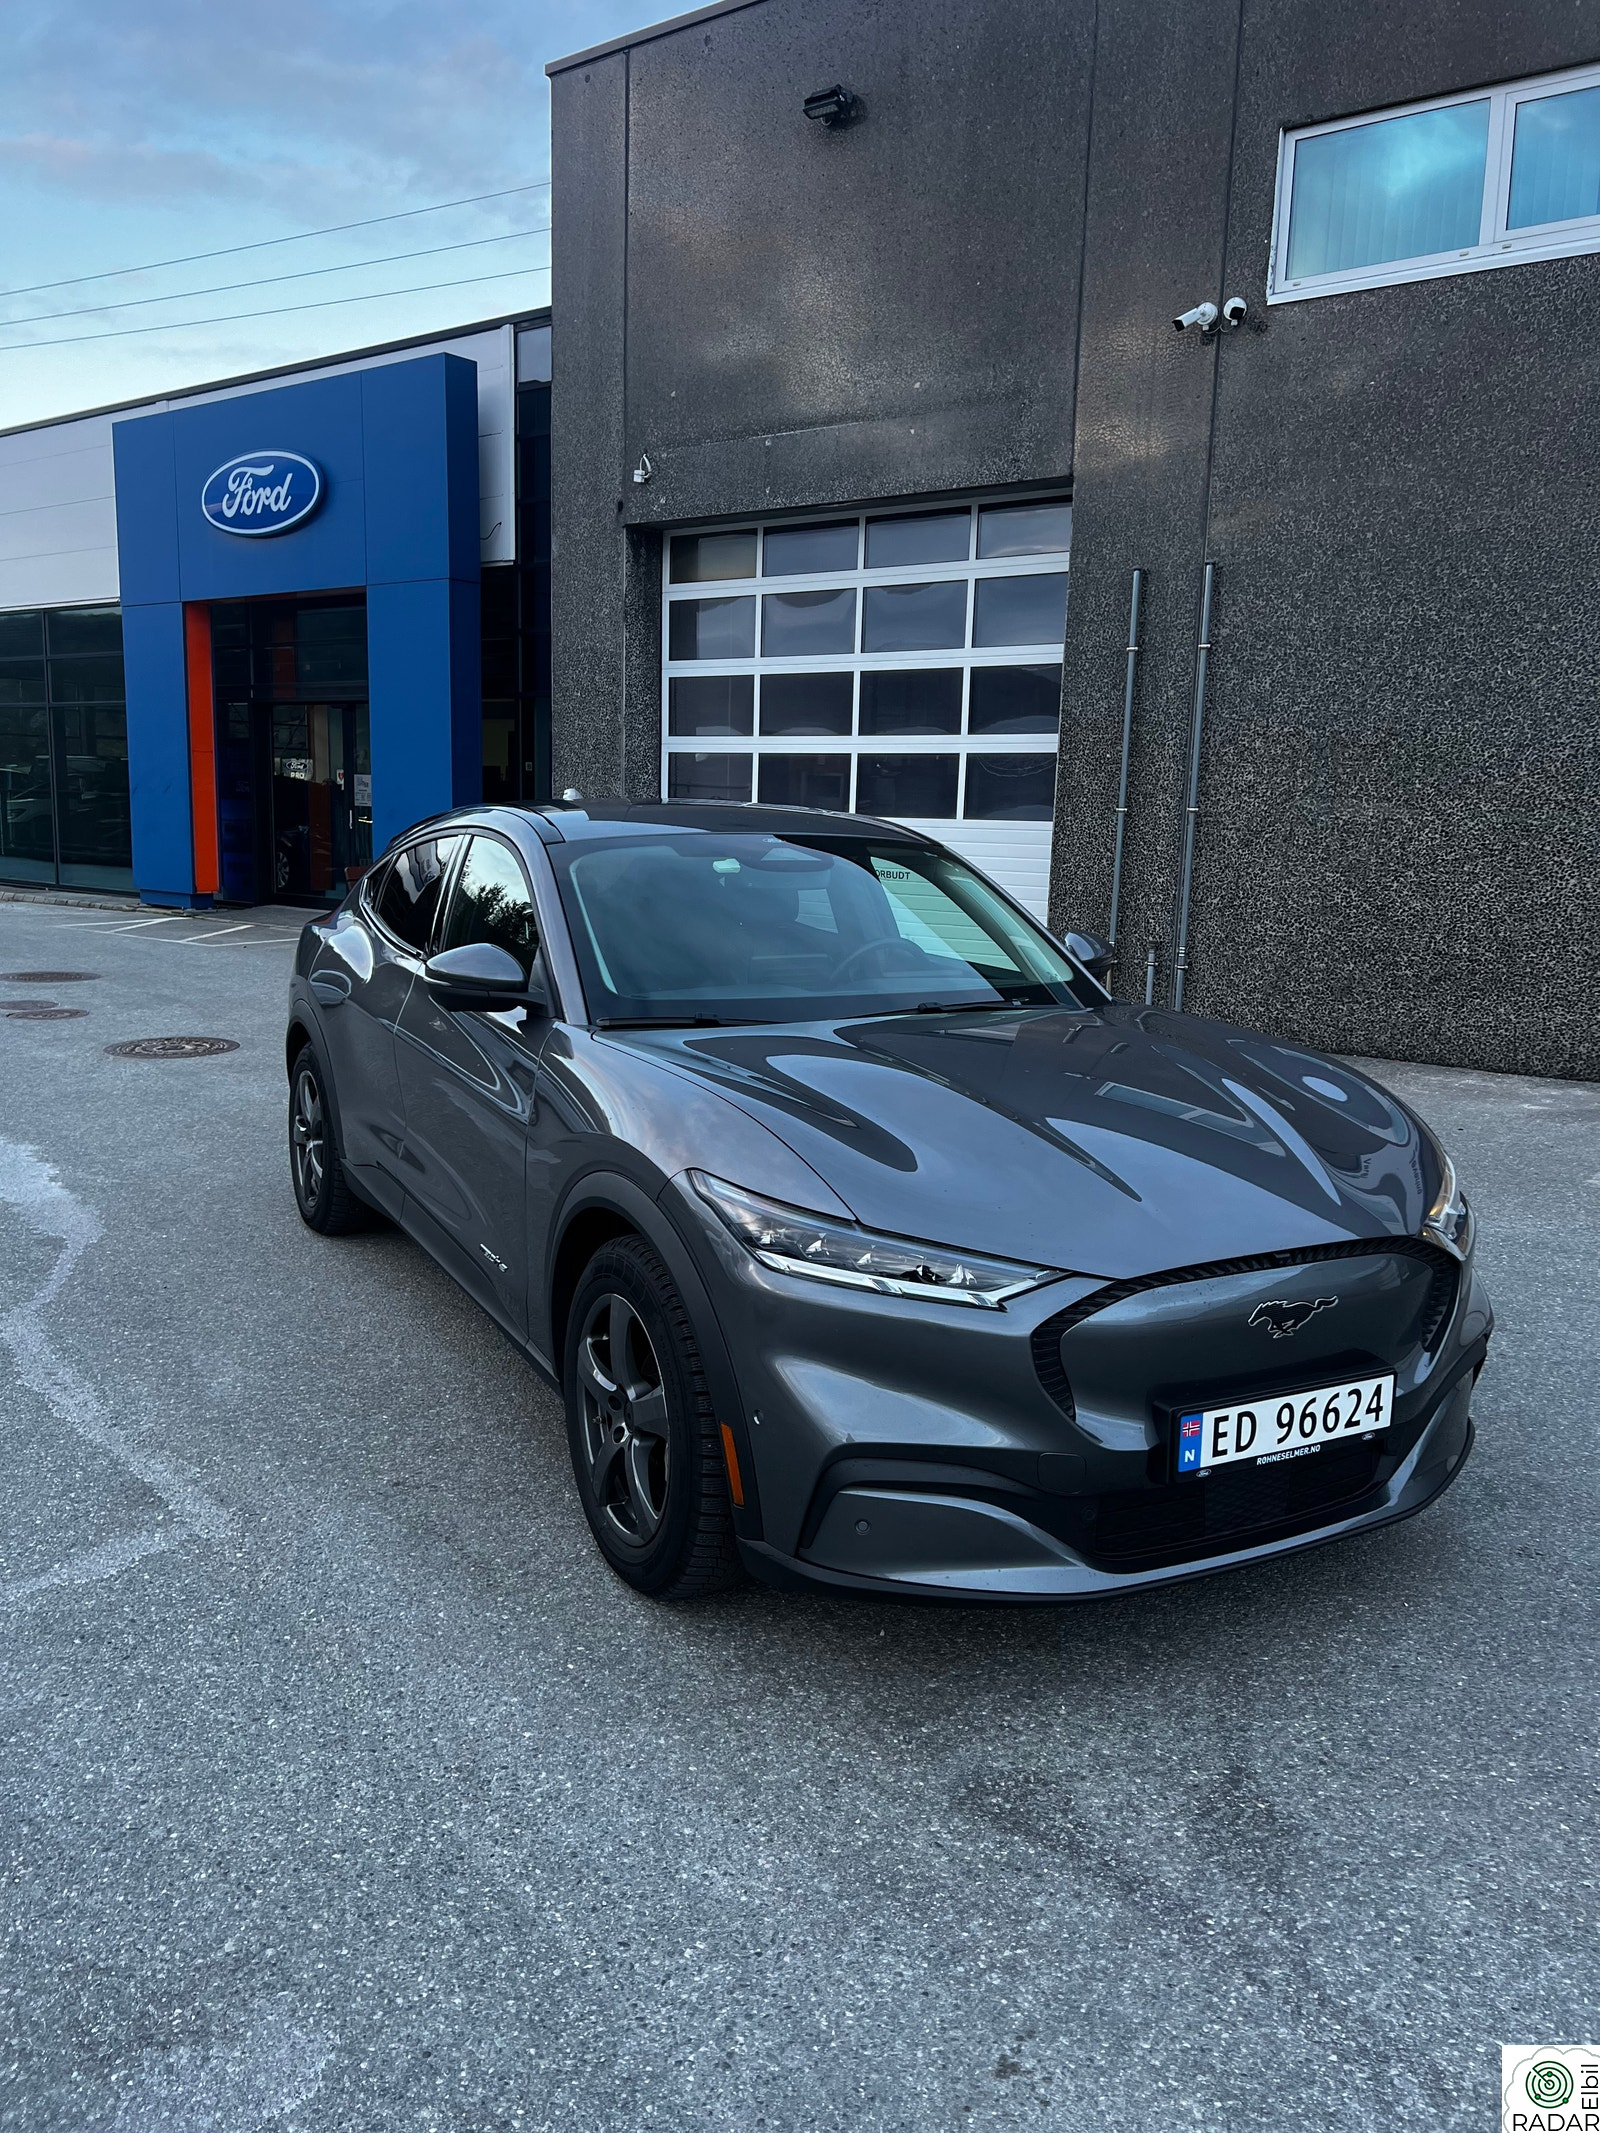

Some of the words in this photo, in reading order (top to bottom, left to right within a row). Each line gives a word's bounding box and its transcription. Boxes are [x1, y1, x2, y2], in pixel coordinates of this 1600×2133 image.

[222, 464, 293, 518] Ford
[1212, 1411, 1257, 1458] ED
[1276, 1384, 1384, 1444] 96624
[1184, 1449, 1195, 1462] N
